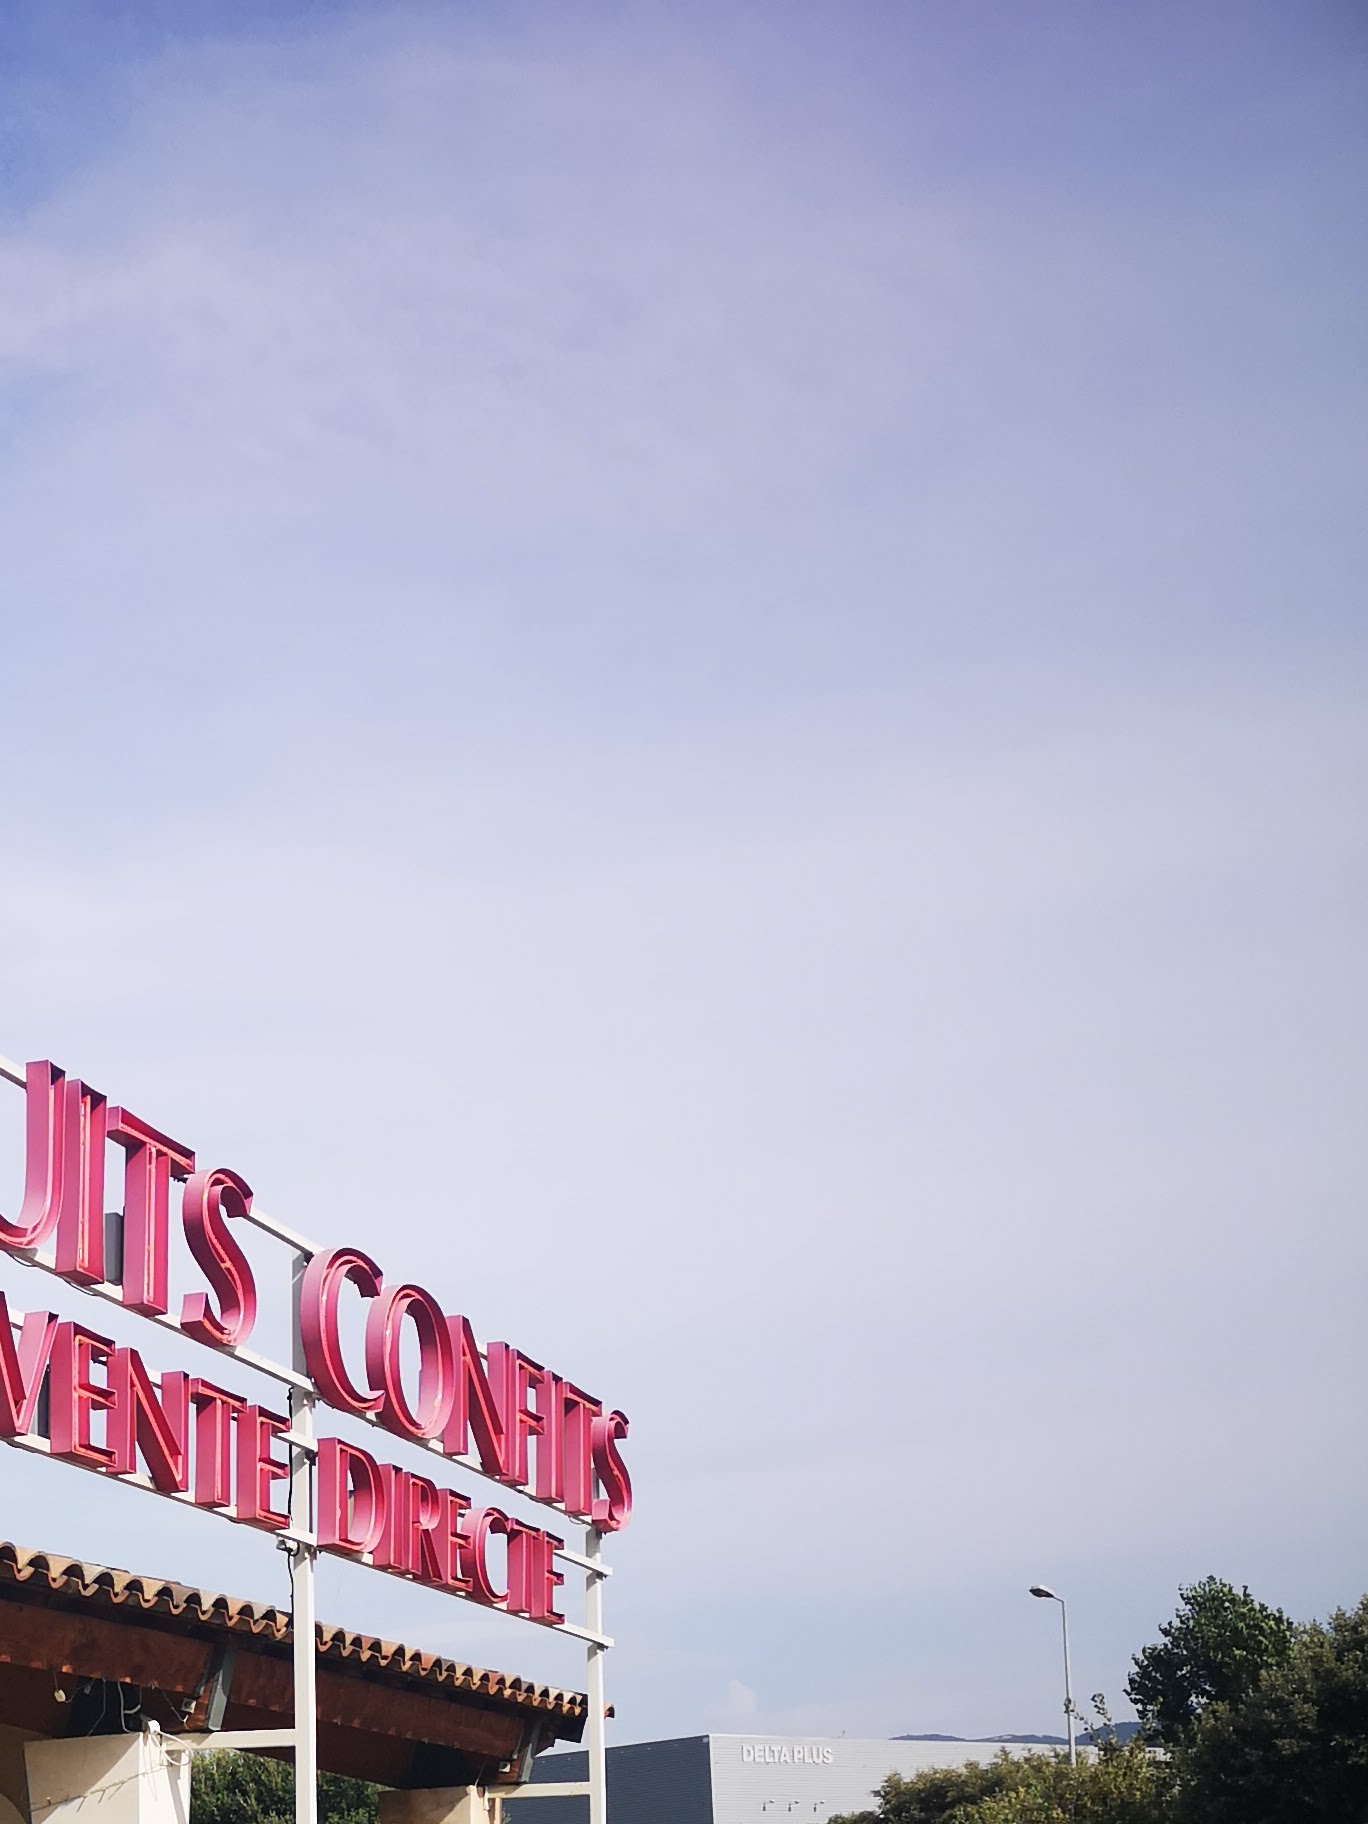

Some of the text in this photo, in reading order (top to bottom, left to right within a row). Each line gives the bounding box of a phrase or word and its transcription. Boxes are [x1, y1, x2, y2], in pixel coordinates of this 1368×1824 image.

[300, 1247, 632, 1533] CONFITS
[317, 1437, 565, 1626] DIRECTE
[741, 1745, 833, 1764] DELTA PLUS
